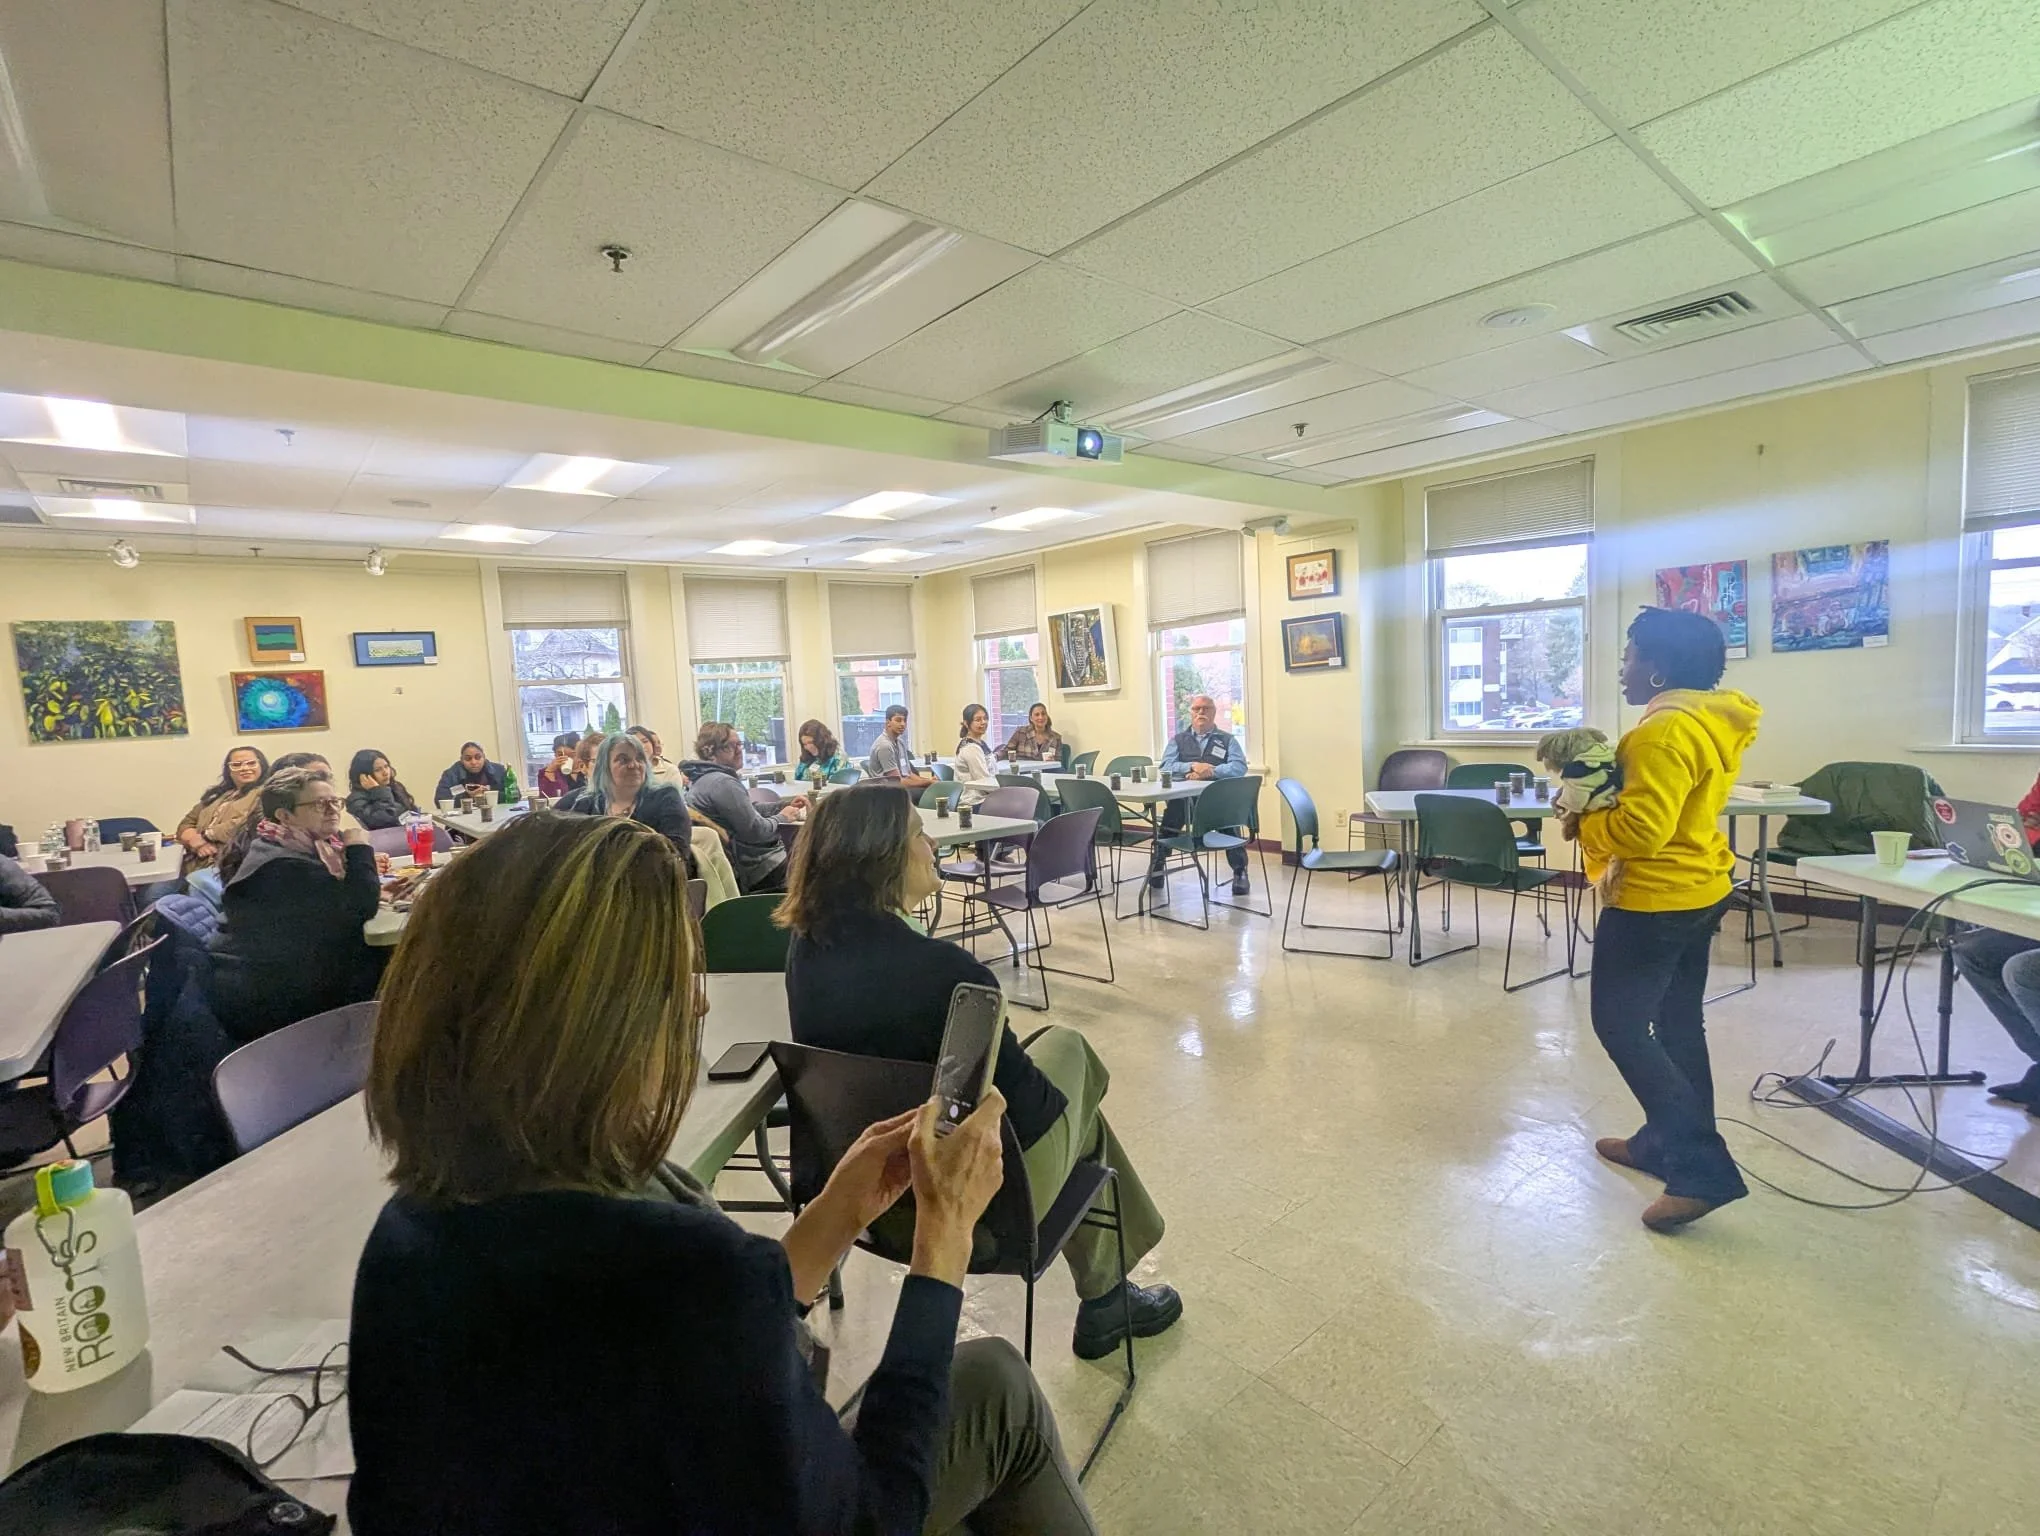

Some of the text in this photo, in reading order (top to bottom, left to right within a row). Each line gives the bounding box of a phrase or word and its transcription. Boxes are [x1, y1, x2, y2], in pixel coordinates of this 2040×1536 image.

[55, 1296, 77, 1373] NEW BRITAIN
[60, 1230, 116, 1369] ROOTS
